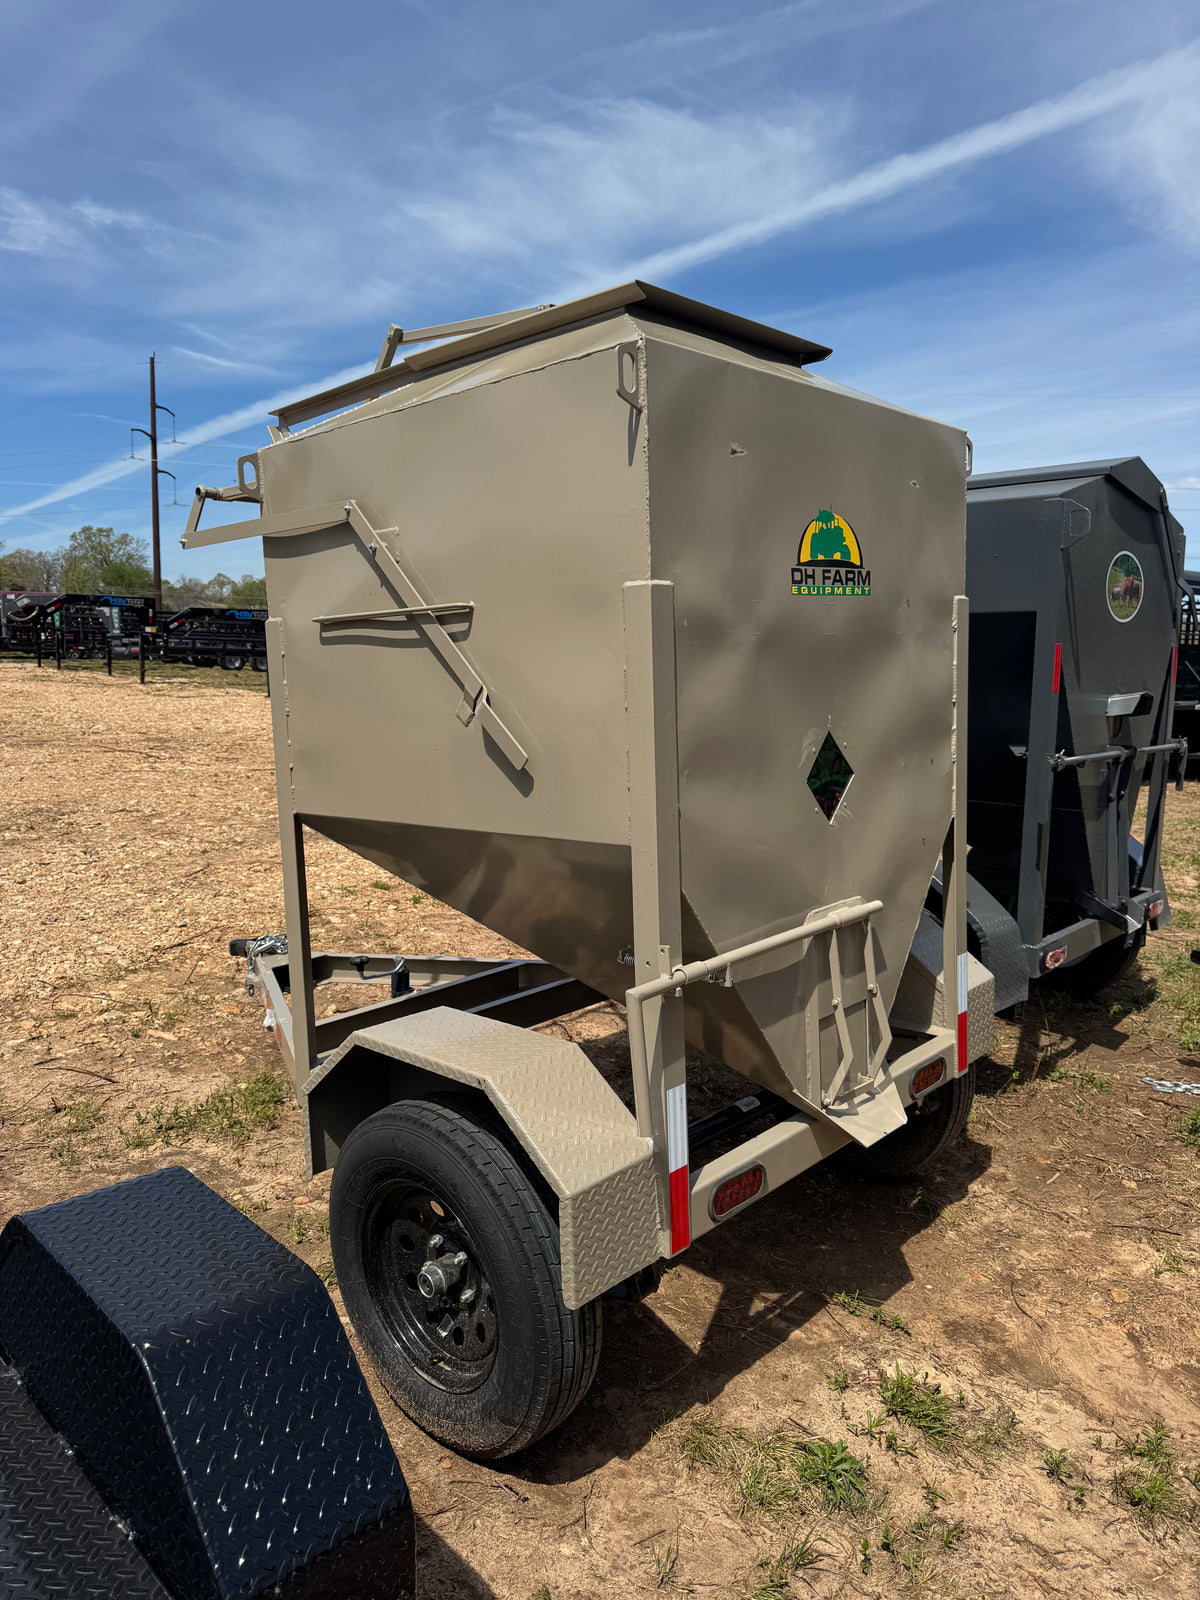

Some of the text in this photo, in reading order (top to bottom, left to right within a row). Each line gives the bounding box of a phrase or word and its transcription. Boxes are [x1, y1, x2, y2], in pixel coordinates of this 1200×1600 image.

[791, 567, 871, 586] DH FARM
[791, 586, 870, 595] EQUIPMENT
